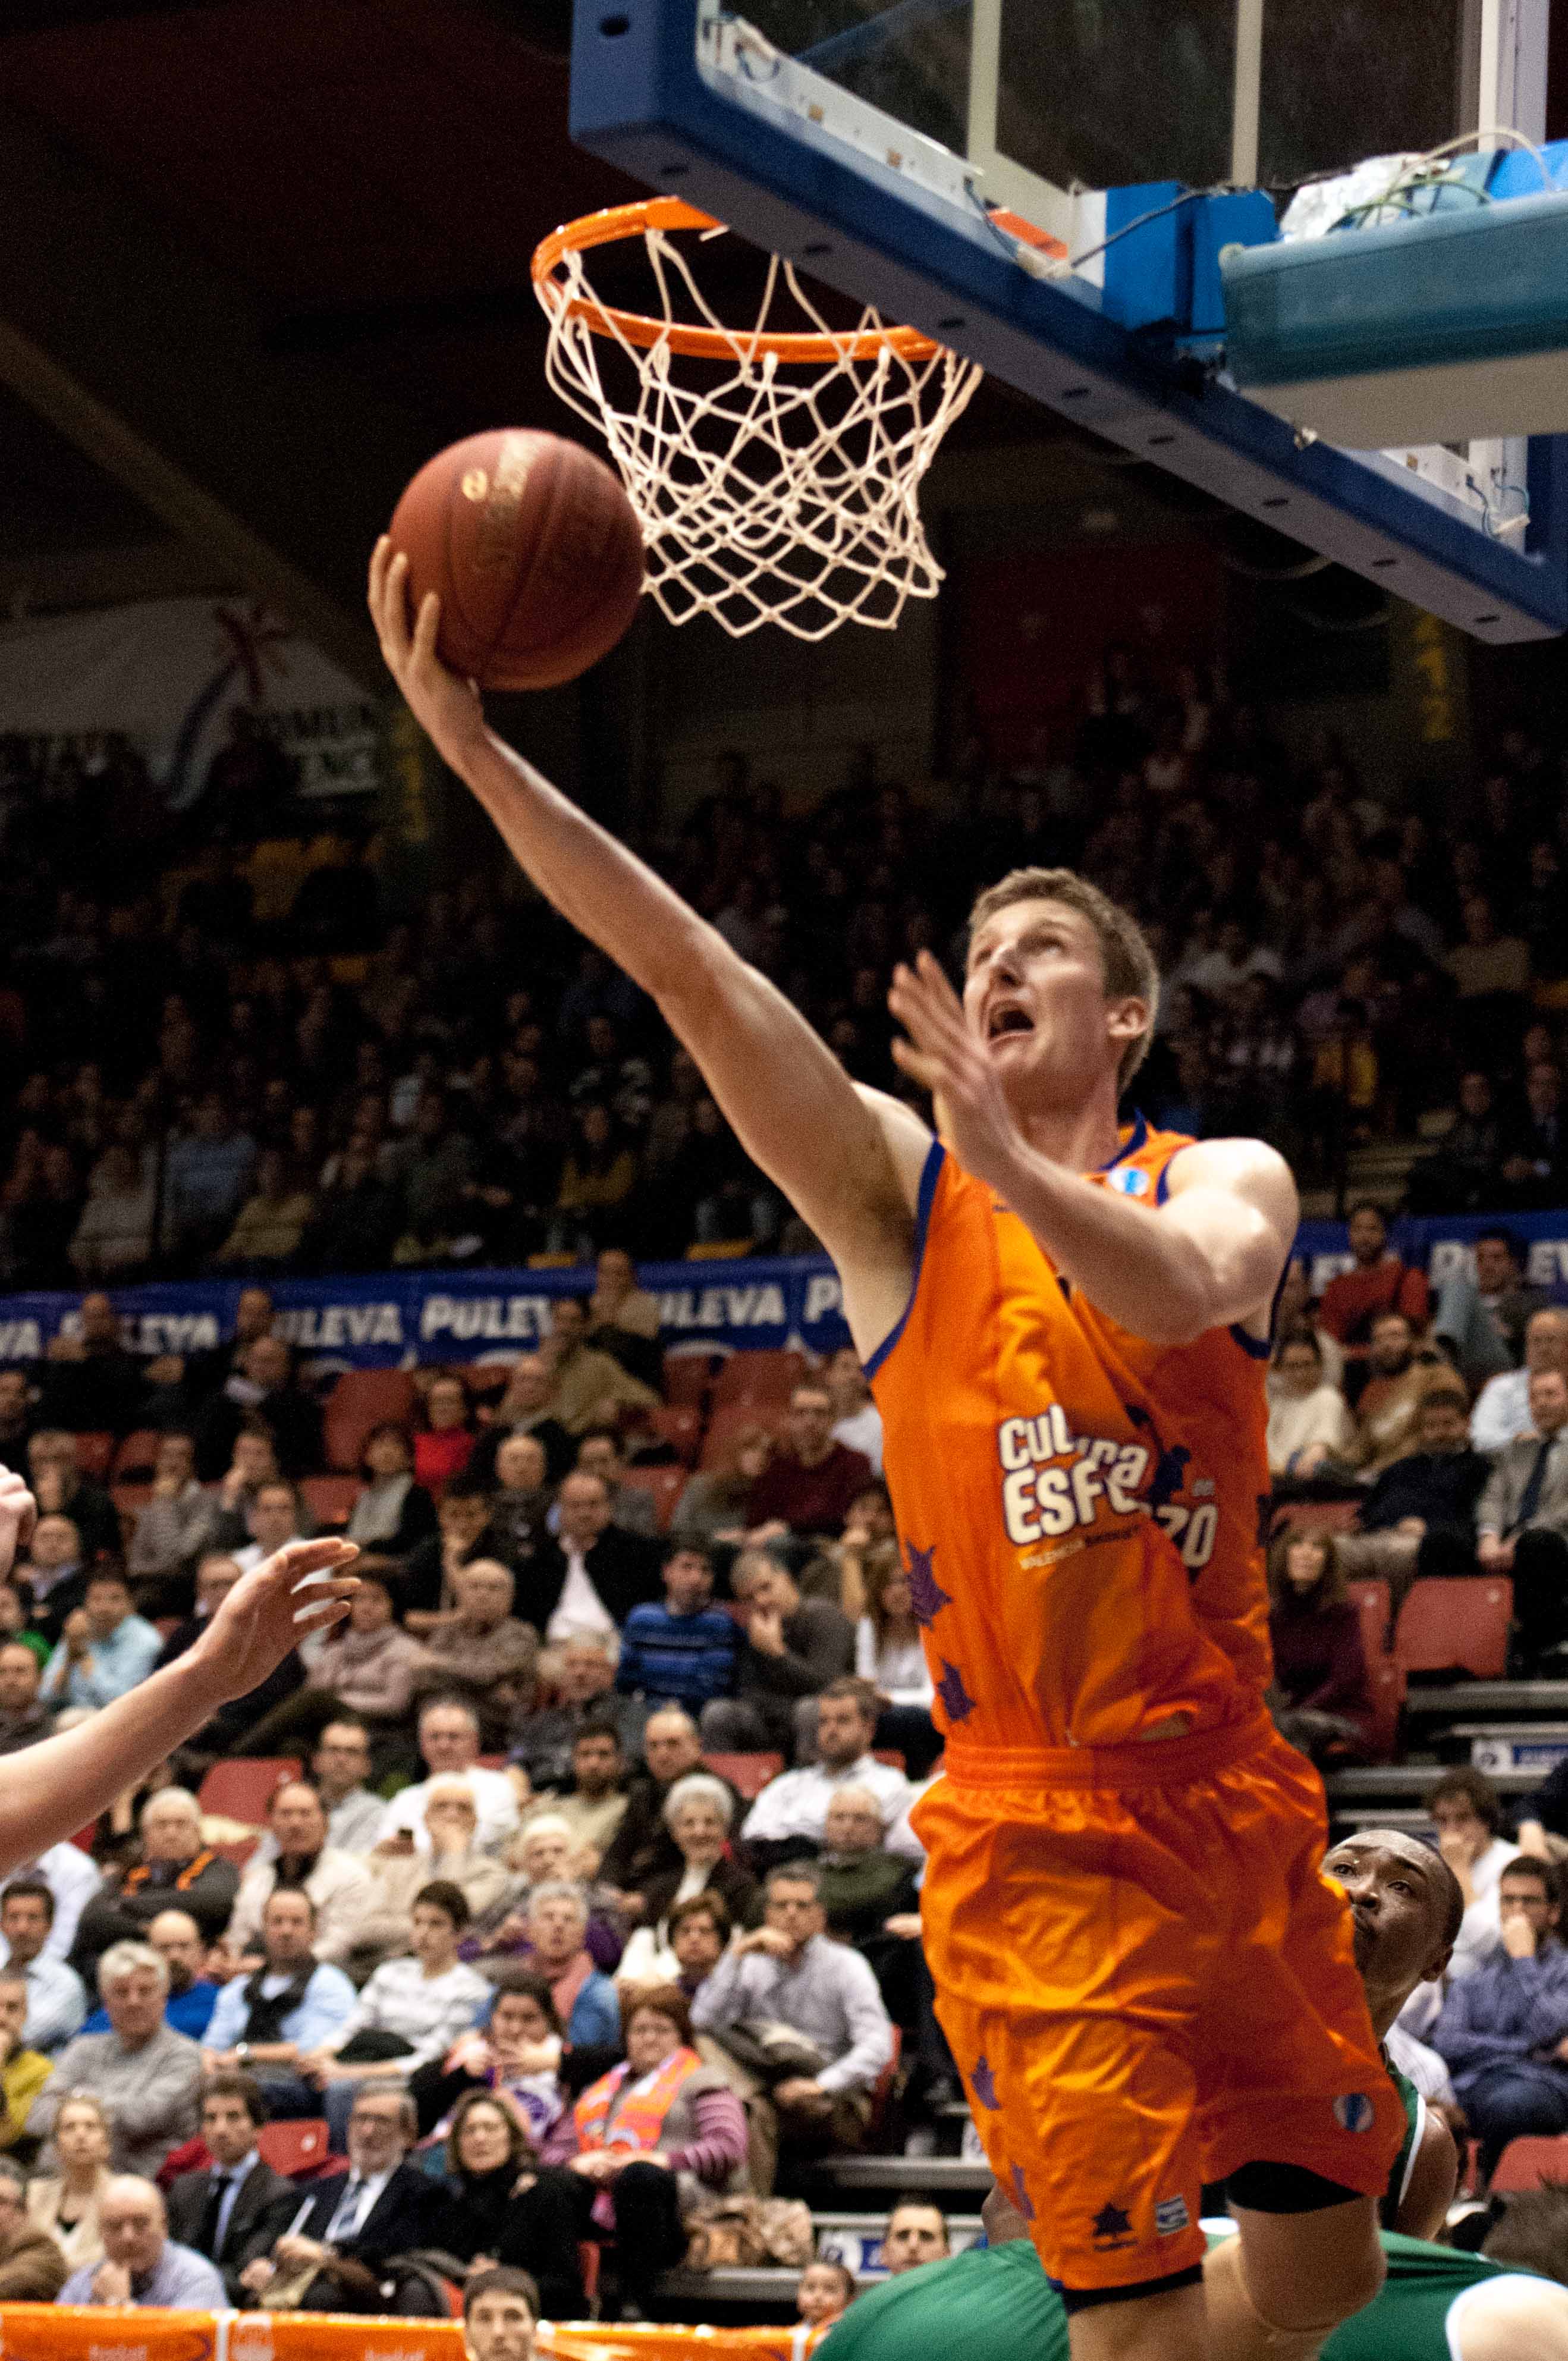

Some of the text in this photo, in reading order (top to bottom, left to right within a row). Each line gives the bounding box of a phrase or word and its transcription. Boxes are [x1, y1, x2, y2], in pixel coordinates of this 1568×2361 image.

[271, 1303, 403, 1348] ULEVA
[420, 1295, 554, 1342] PULEV
[653, 1283, 785, 1329] ULEVA
